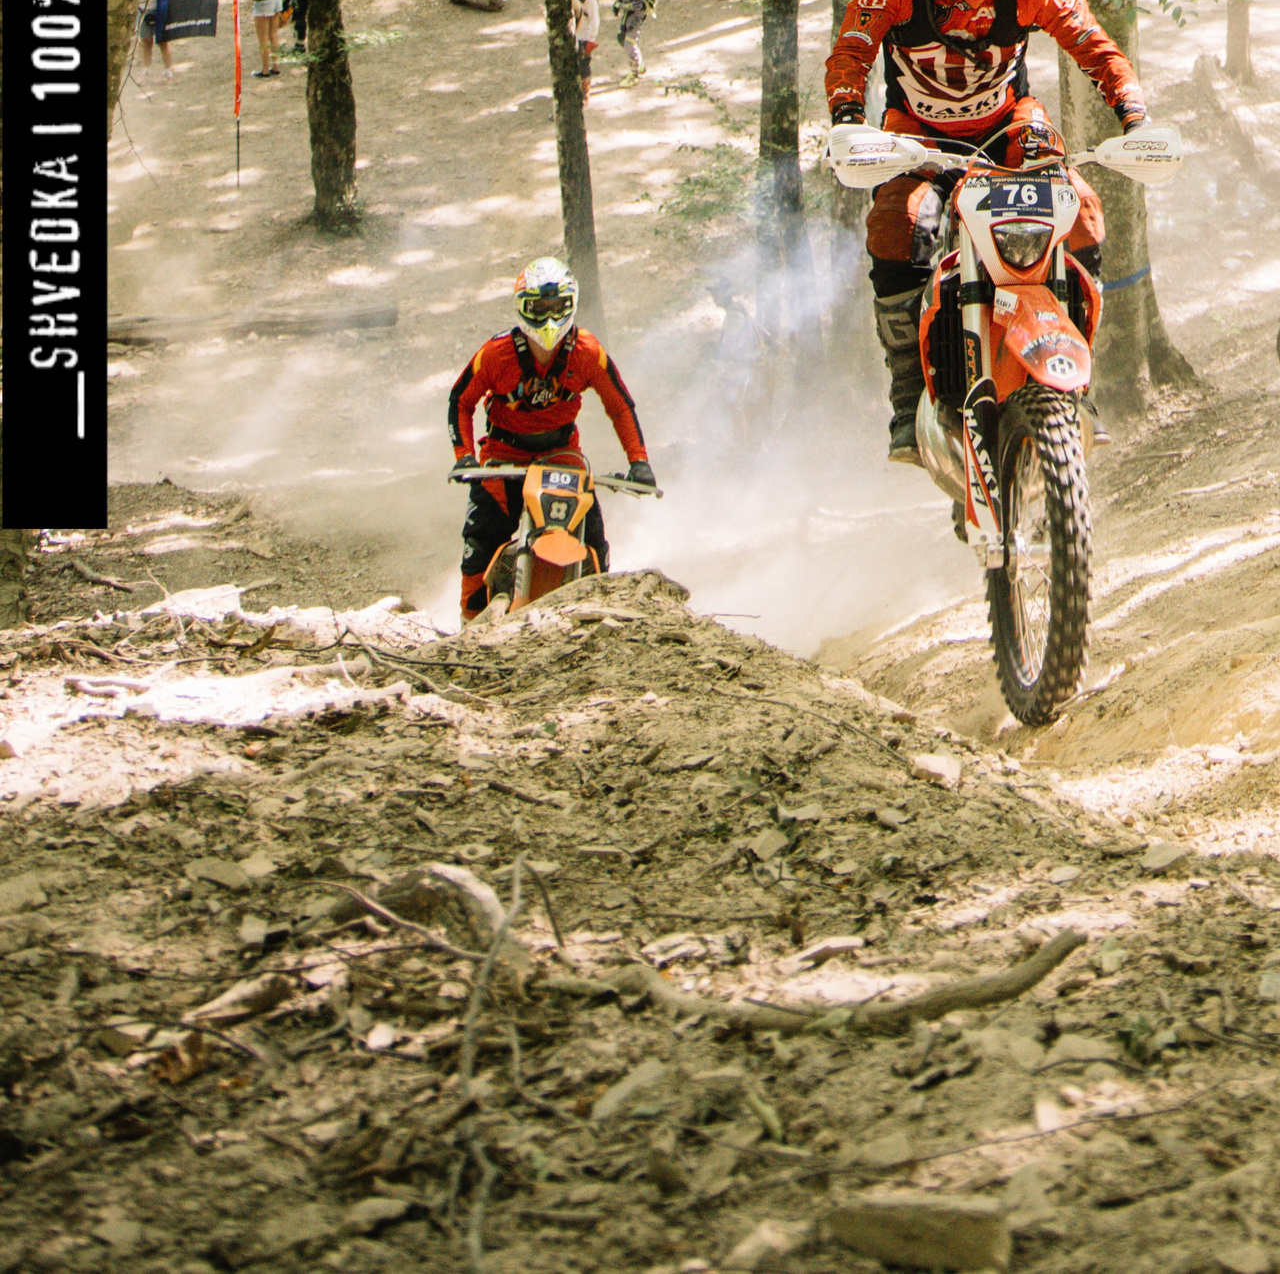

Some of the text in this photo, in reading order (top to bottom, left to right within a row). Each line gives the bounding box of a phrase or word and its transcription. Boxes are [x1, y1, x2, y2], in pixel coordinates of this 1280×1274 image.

[1002, 184, 1038, 205] 76
[964, 408, 1001, 501] HASKY
[548, 472, 572, 485] 80
